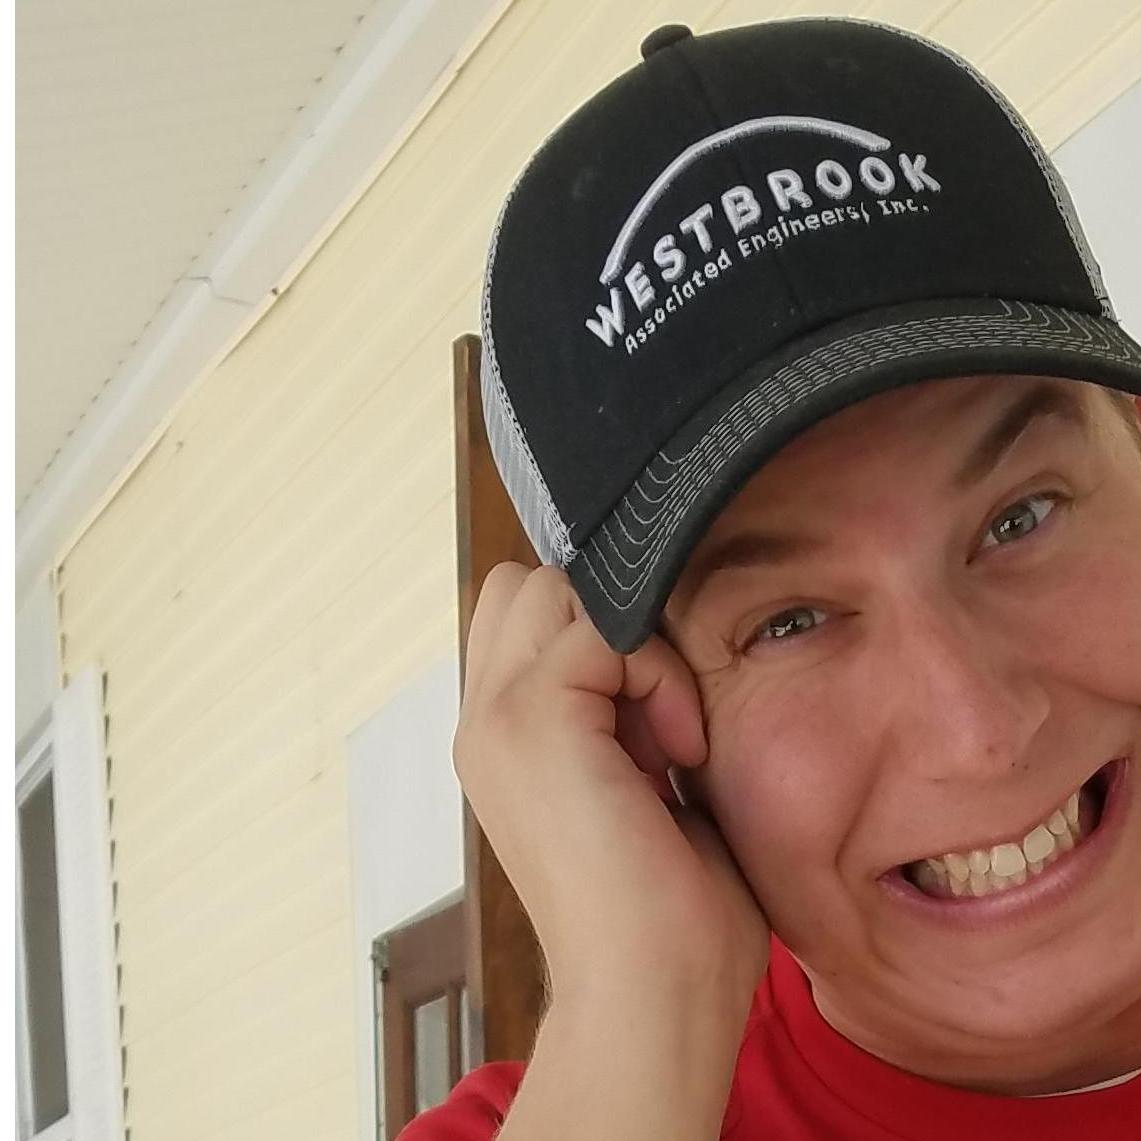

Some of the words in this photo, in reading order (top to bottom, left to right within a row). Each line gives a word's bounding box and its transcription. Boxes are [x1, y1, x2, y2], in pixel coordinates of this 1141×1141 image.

[585, 153, 942, 348] WESTBROOK
[625, 249, 733, 355] Associated
[877, 197, 931, 216] Inc.
